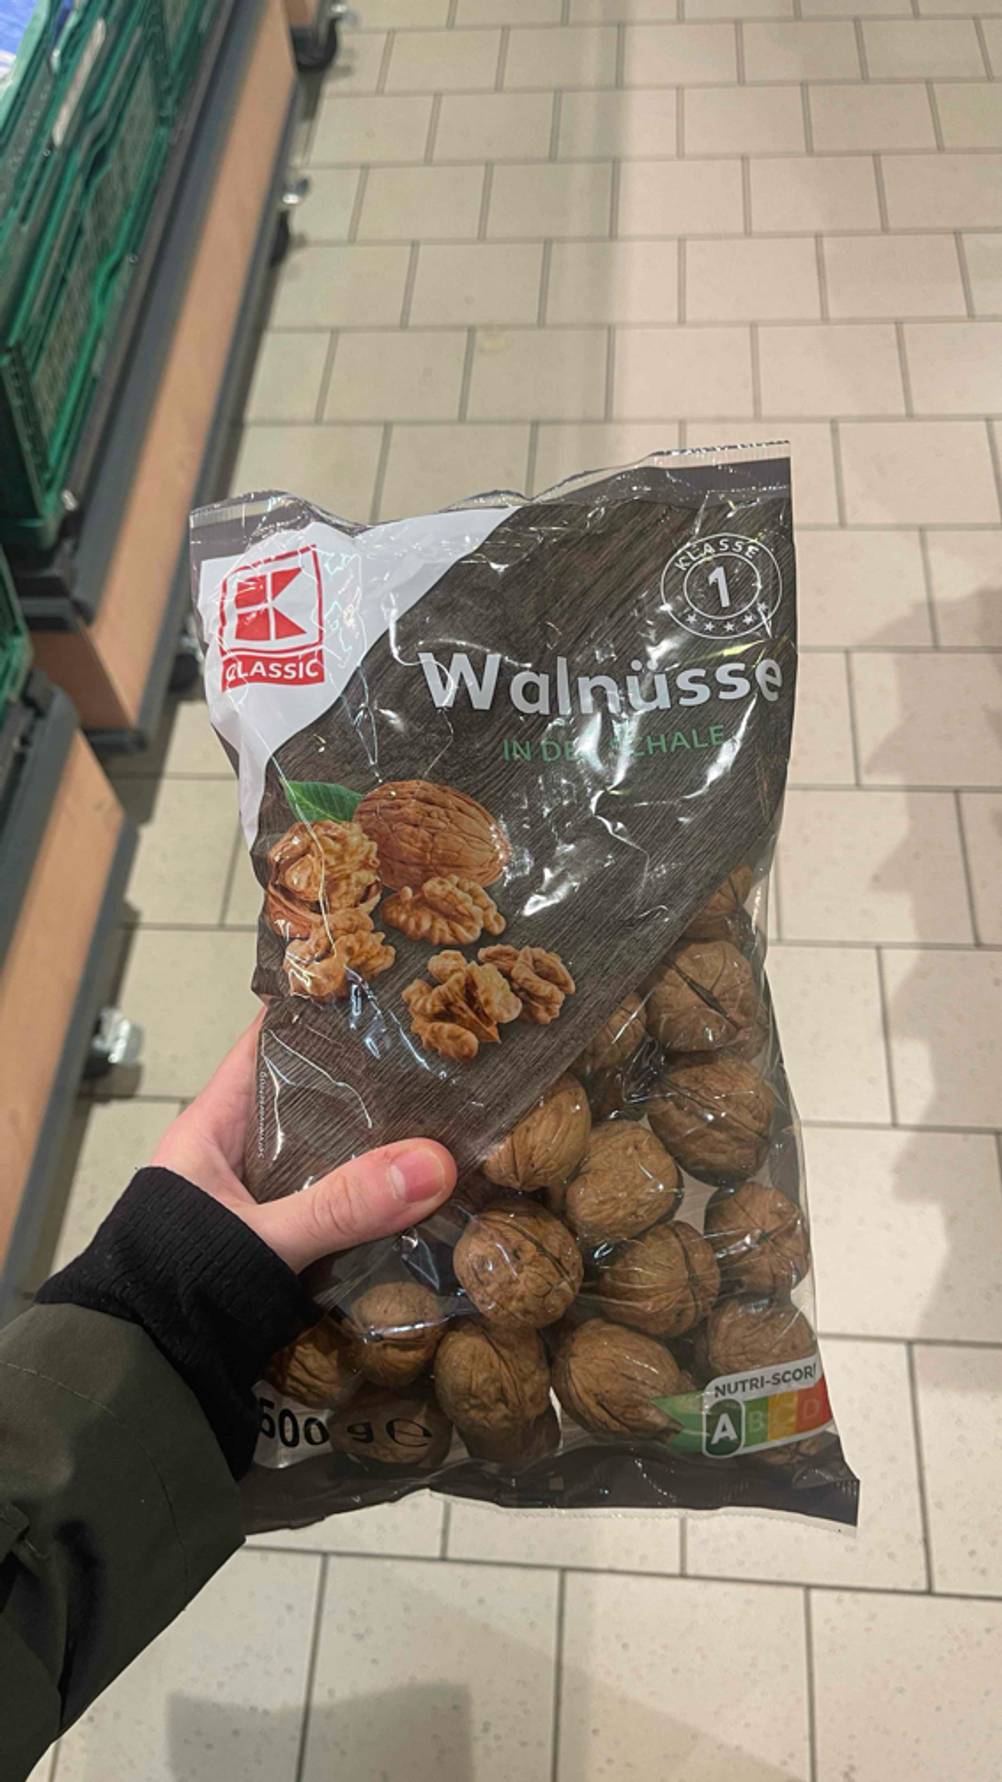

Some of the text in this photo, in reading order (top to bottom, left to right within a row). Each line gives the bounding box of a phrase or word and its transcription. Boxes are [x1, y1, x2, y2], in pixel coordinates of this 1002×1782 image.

[674, 538, 760, 571] KLASSE
[708, 566, 730, 608] 1
[225, 659, 319, 682] CLASSIC
[418, 652, 783, 716] Walnüsse
[503, 739, 532, 762] IN
[540, 740, 592, 763] DE
[347, 1421, 373, 1444] g
[711, 1412, 738, 1445] A
